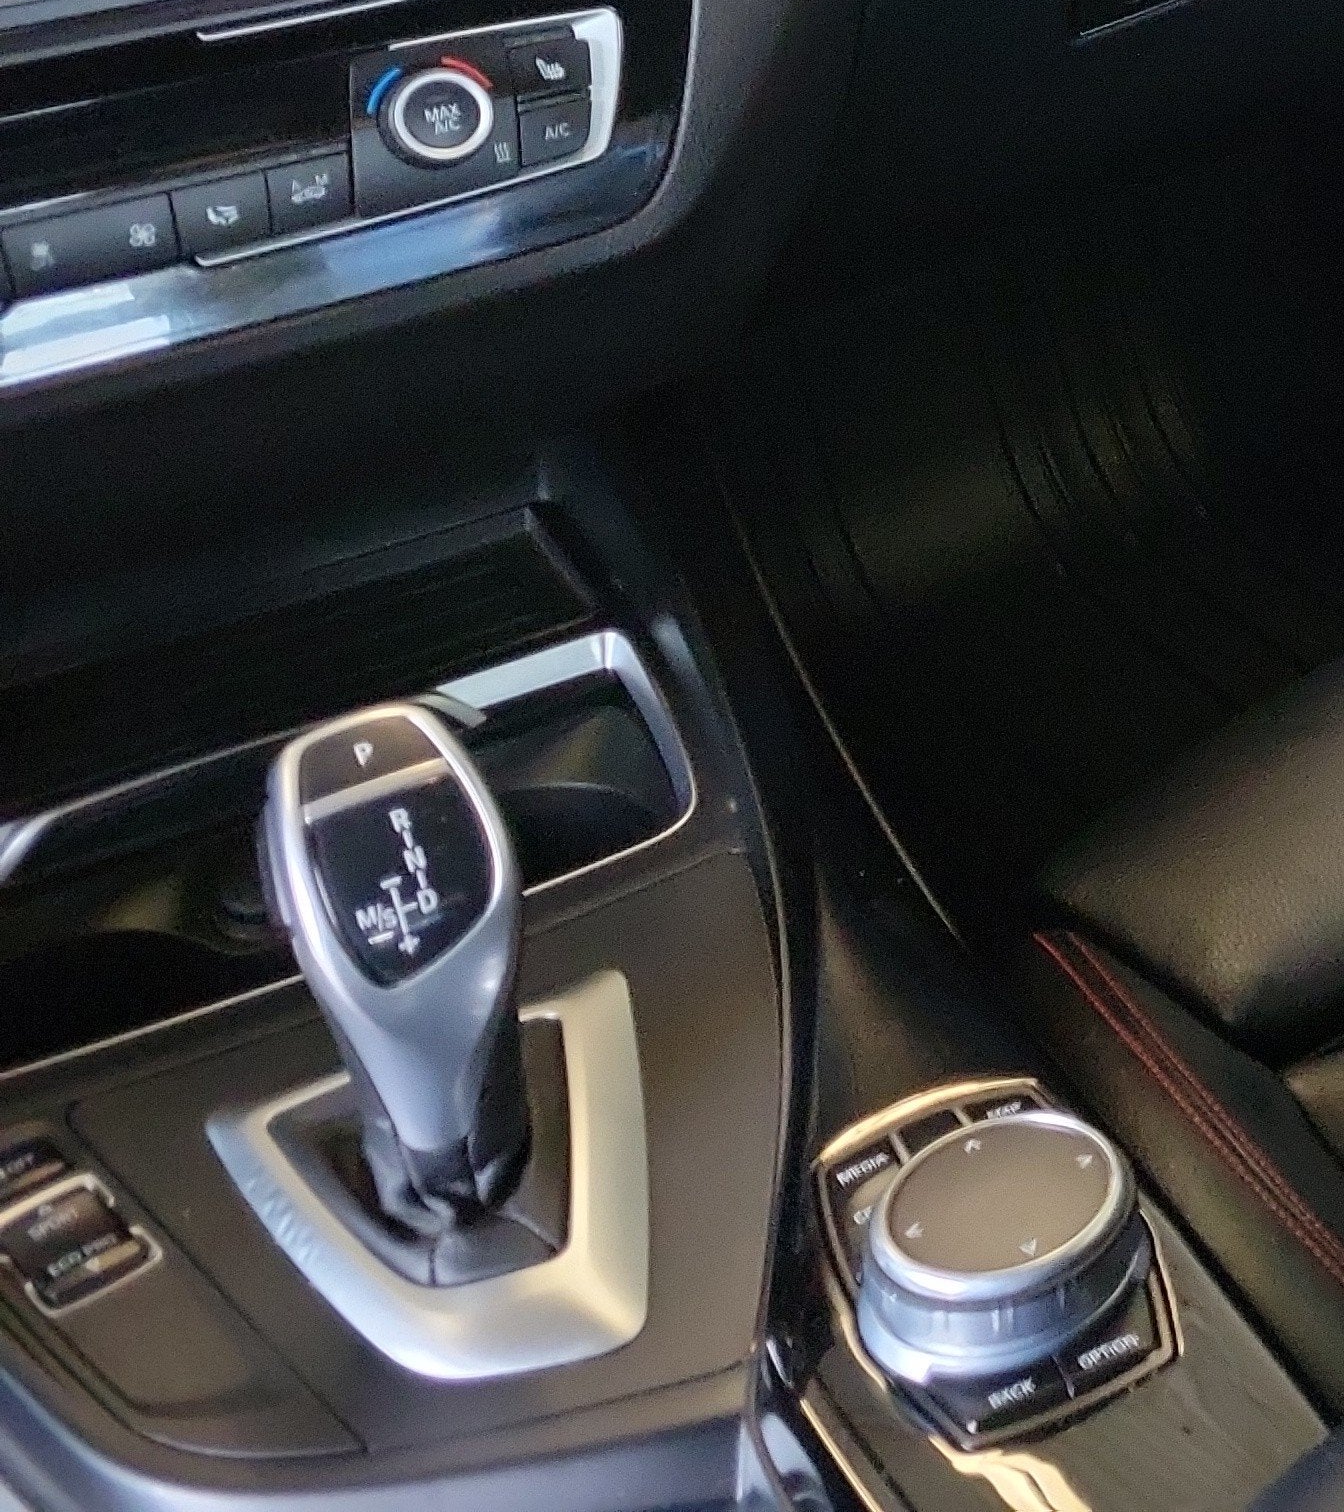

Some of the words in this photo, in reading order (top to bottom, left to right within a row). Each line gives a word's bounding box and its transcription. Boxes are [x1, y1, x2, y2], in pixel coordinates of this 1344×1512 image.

[424, 101, 461, 124] MAX
[544, 124, 571, 140] A/C
[352, 741, 374, 767] P
[388, 807, 412, 834] R
[403, 845, 428, 874] N
[417, 887, 439, 915] D
[836, 1151, 890, 1189] MEDIA
[1077, 1333, 1140, 1371] OPTION
[987, 1375, 1037, 1409] BACK
